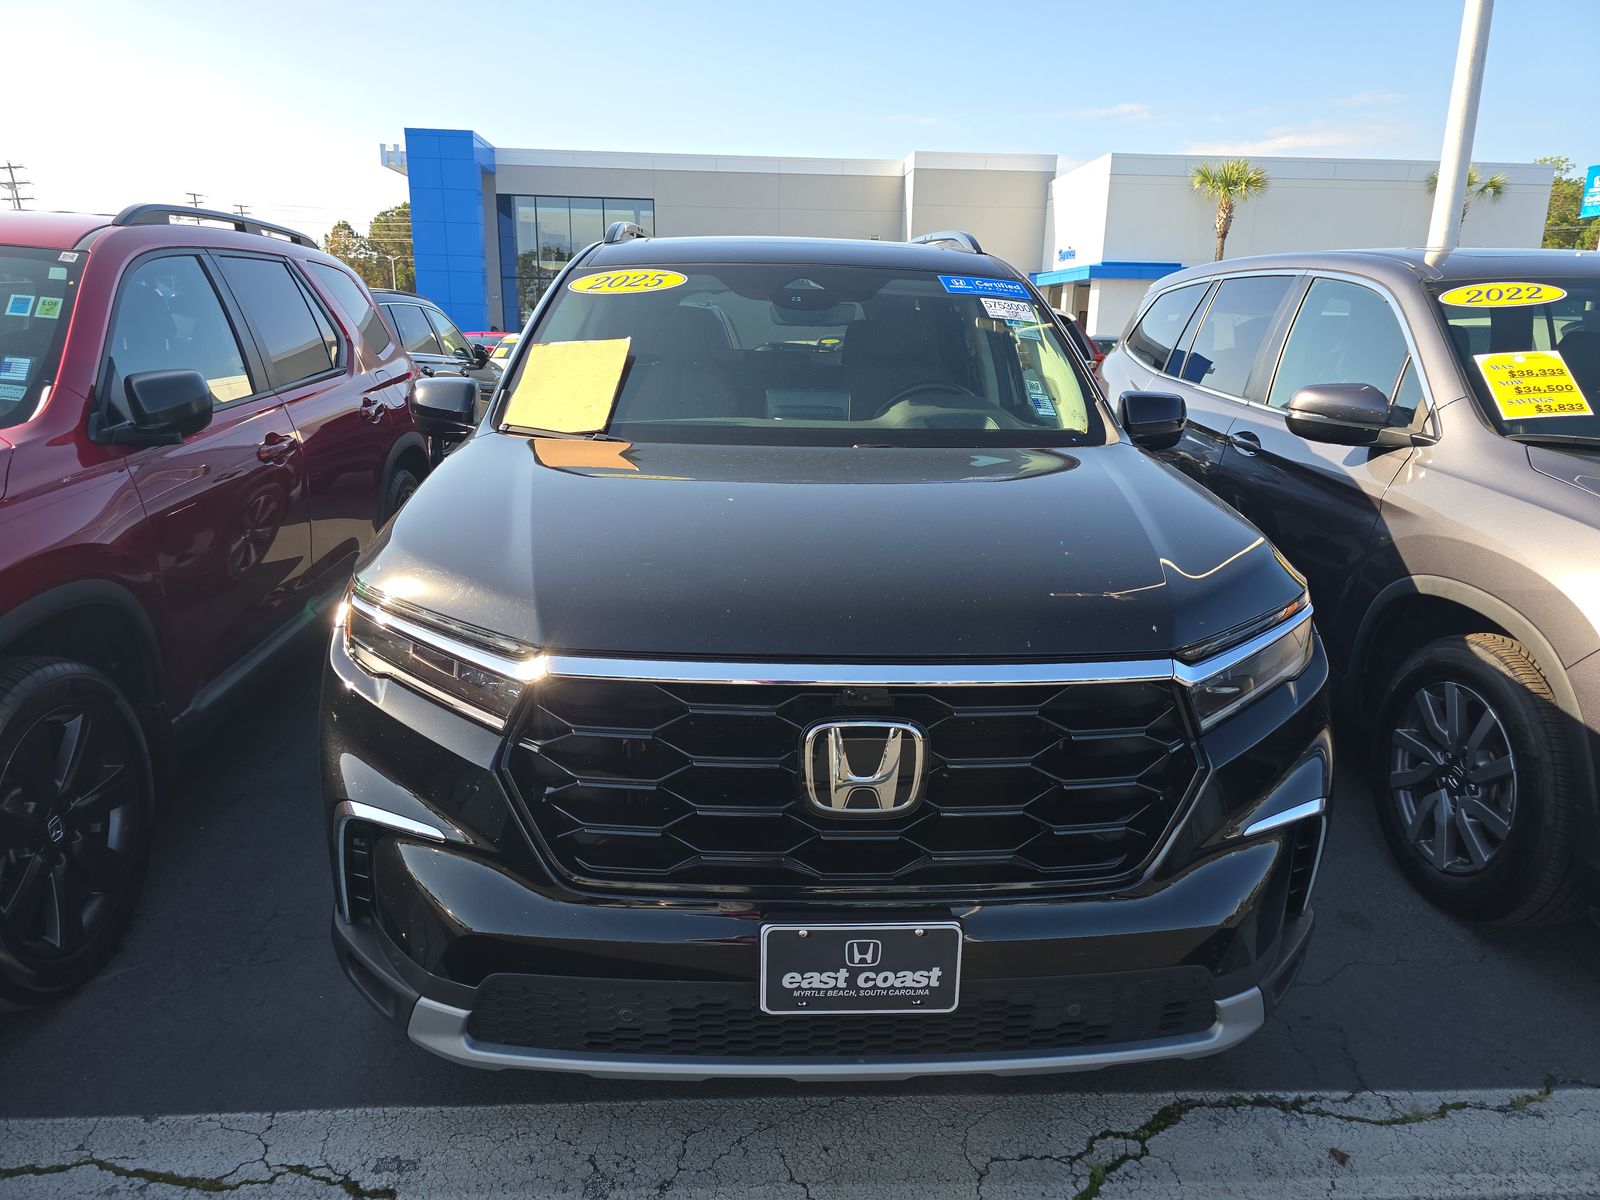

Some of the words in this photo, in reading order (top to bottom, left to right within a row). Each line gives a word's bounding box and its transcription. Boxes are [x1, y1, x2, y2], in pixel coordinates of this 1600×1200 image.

[587, 274, 669, 290] 2025
[975, 280, 1021, 290] Certified
[1465, 286, 1544, 304] 2022
[984, 300, 1031, 313] 5753000
[1490, 363, 1515, 371] WAS
[1508, 368, 1566, 379] $38,333
[1514, 384, 1574, 395] $34,500
[1507, 397, 1555, 405] SAVINGS
[1535, 403, 1585, 413] $3,833
[781, 968, 849, 989] east
[856, 966, 942, 988] coast
[827, 989, 857, 997] BEACH,
[859, 989, 887, 997] SOUTH
[888, 988, 930, 996] CAROLINA
